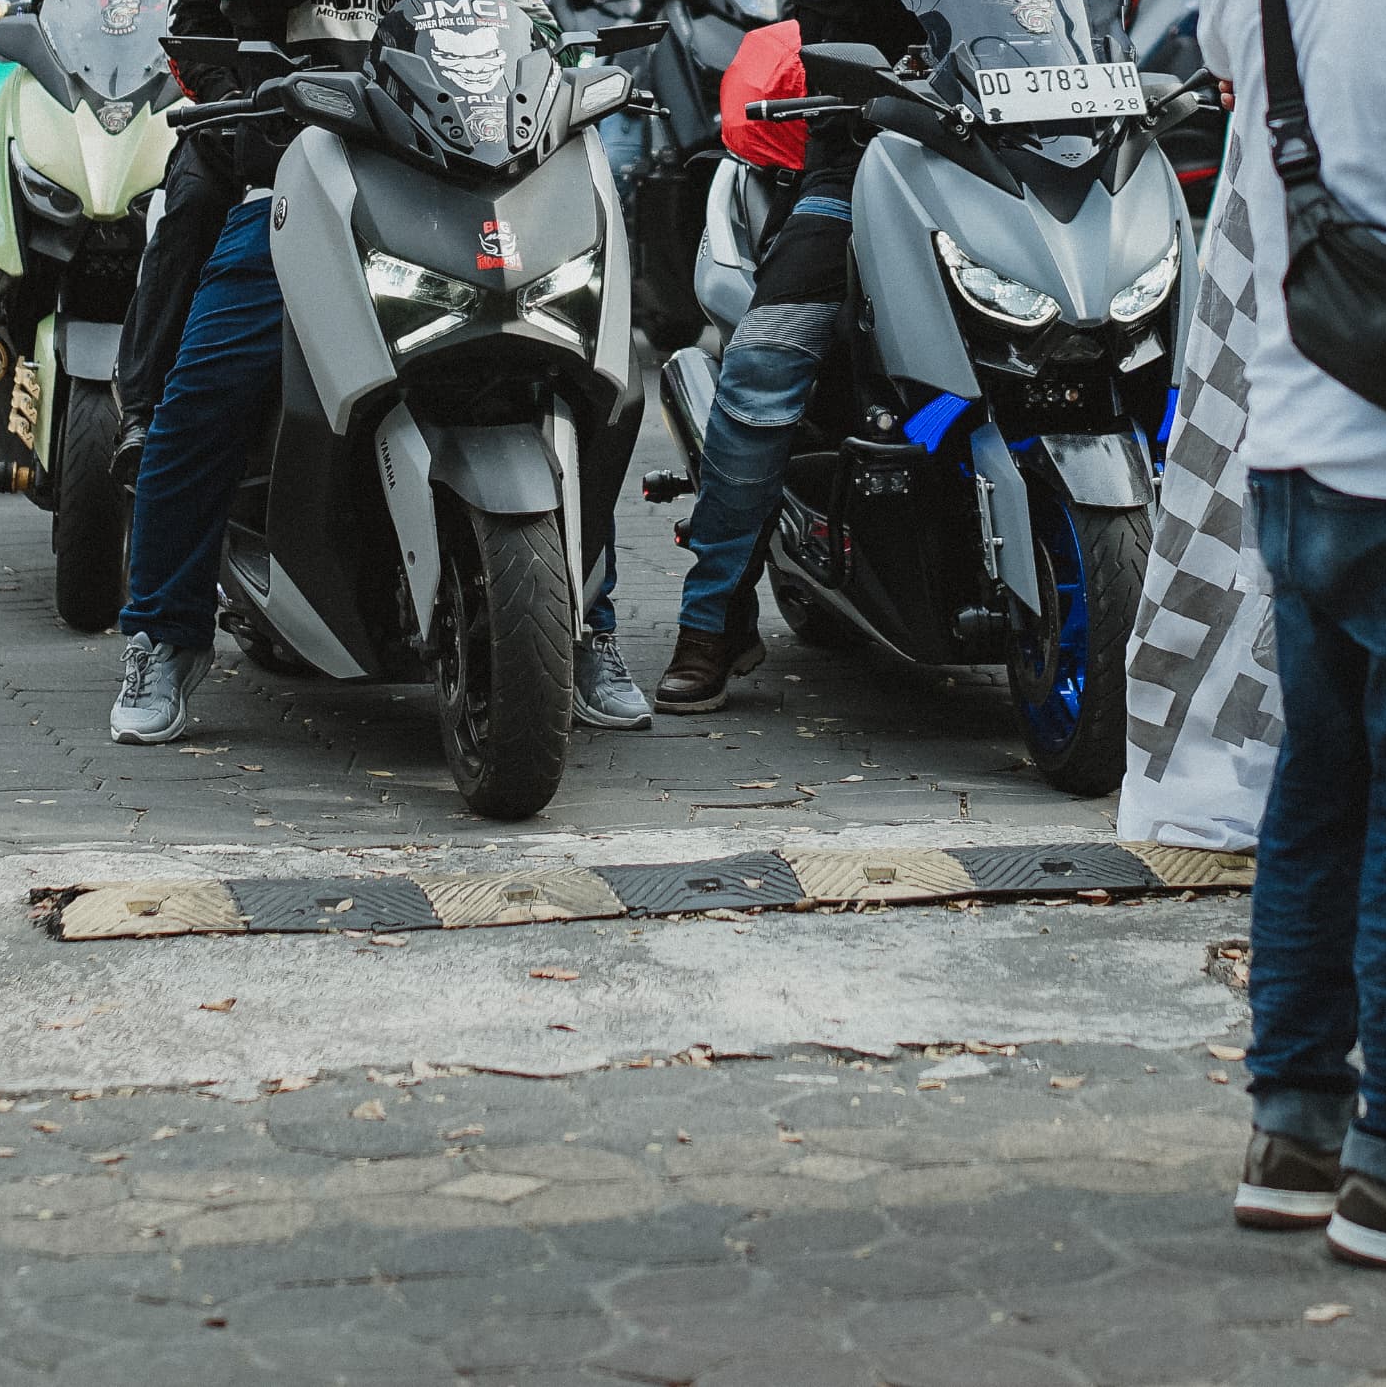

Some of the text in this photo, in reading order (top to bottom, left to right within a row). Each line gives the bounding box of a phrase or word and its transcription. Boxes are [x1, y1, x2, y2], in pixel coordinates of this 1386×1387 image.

[415, 19, 438, 31] JOKER
[438, 16, 455, 28] MAX
[456, 16, 475, 26] CLUB
[980, 65, 1136, 96] DD 3783 YH
[381, 437, 396, 490] YAMAHA
